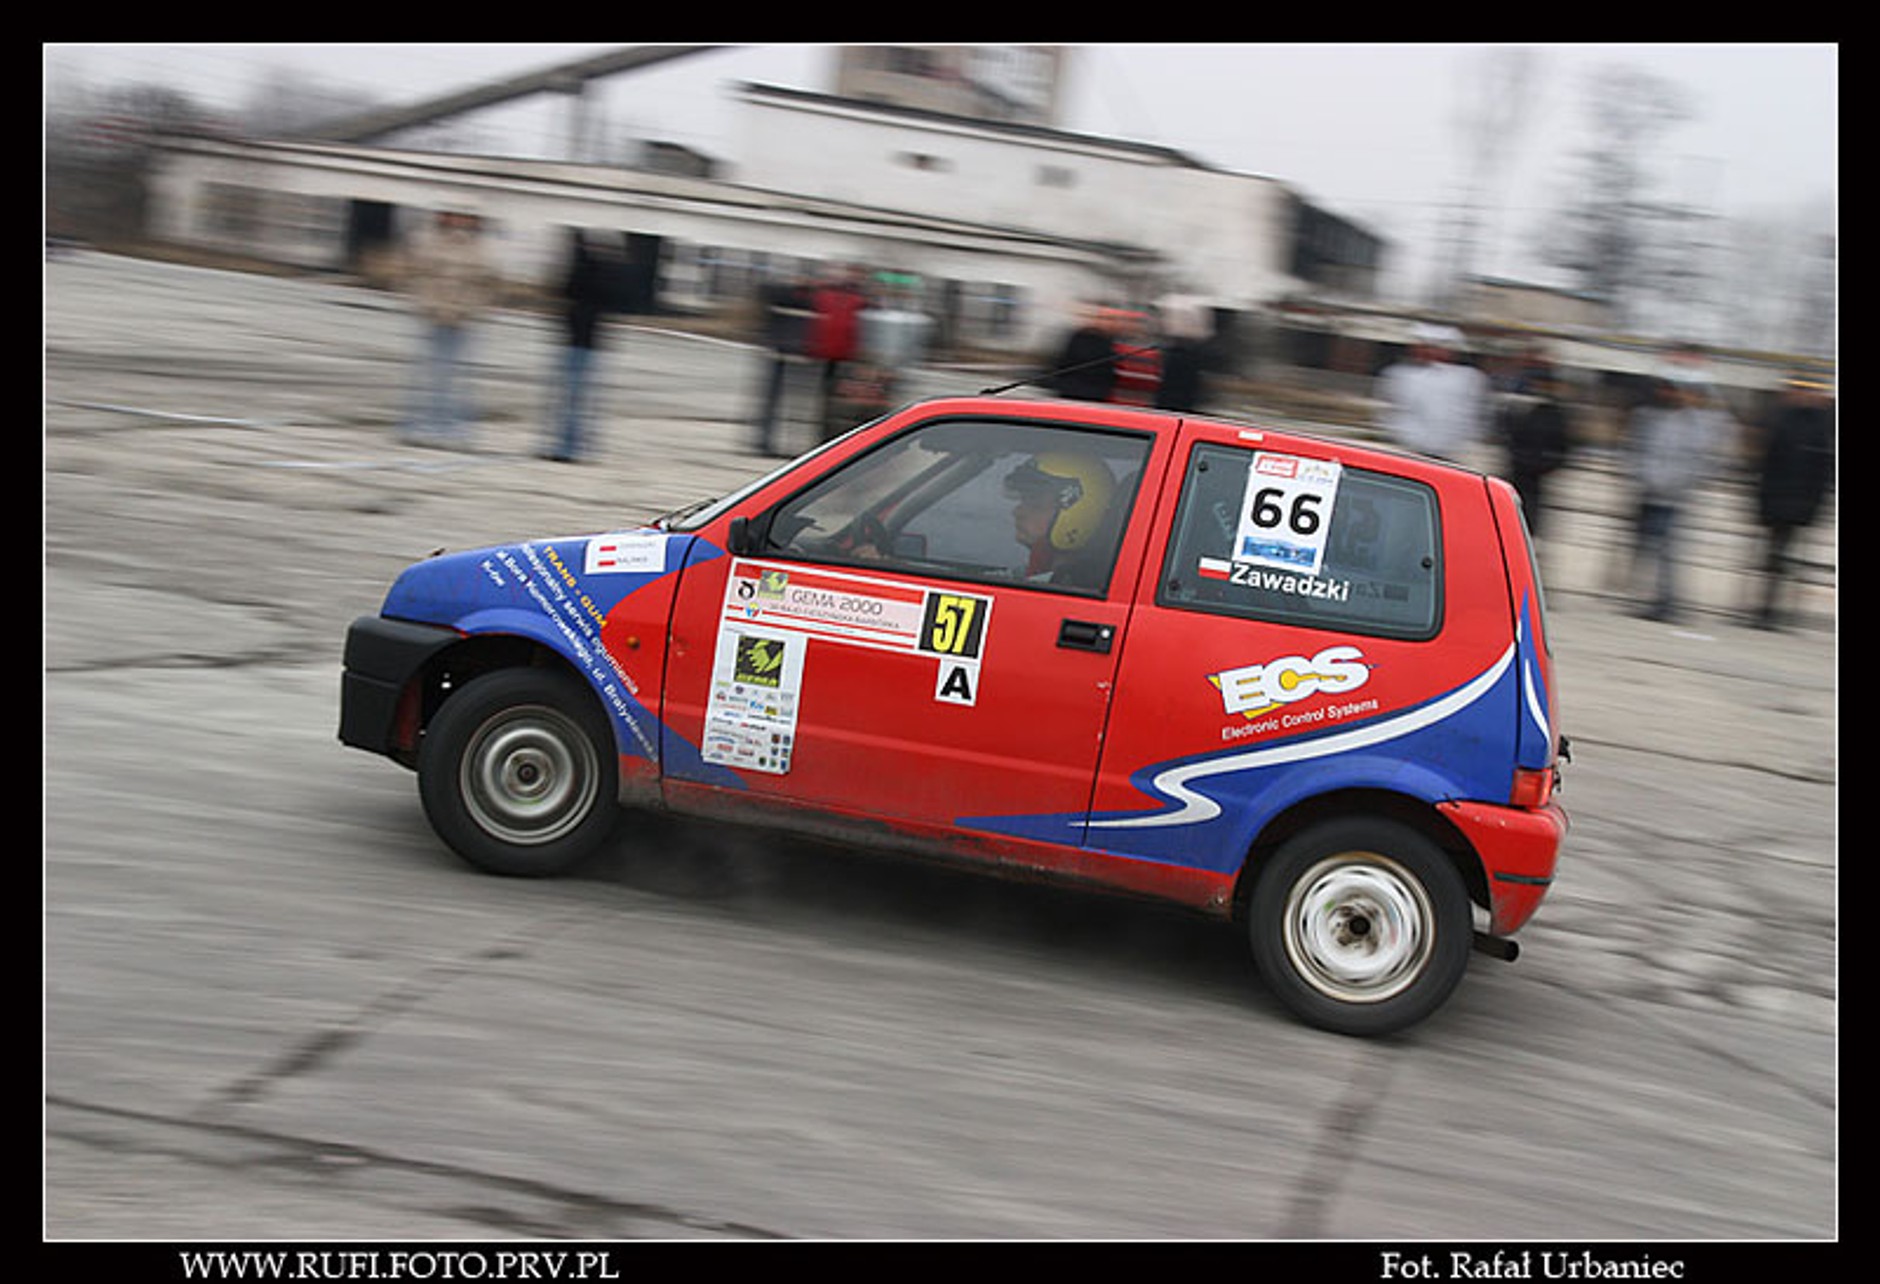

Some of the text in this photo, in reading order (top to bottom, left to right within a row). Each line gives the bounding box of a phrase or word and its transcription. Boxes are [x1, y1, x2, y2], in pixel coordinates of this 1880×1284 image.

[1251, 487, 1322, 535] 66
[791, 588, 883, 616] GEMA 2000
[1230, 562, 1350, 602] Zawadzki
[580, 595, 607, 629] GUM
[932, 594, 976, 654] 57
[940, 666, 972, 700] A
[1219, 646, 1371, 714] ECS
[1221, 698, 1380, 741] Electronic Control Systems
